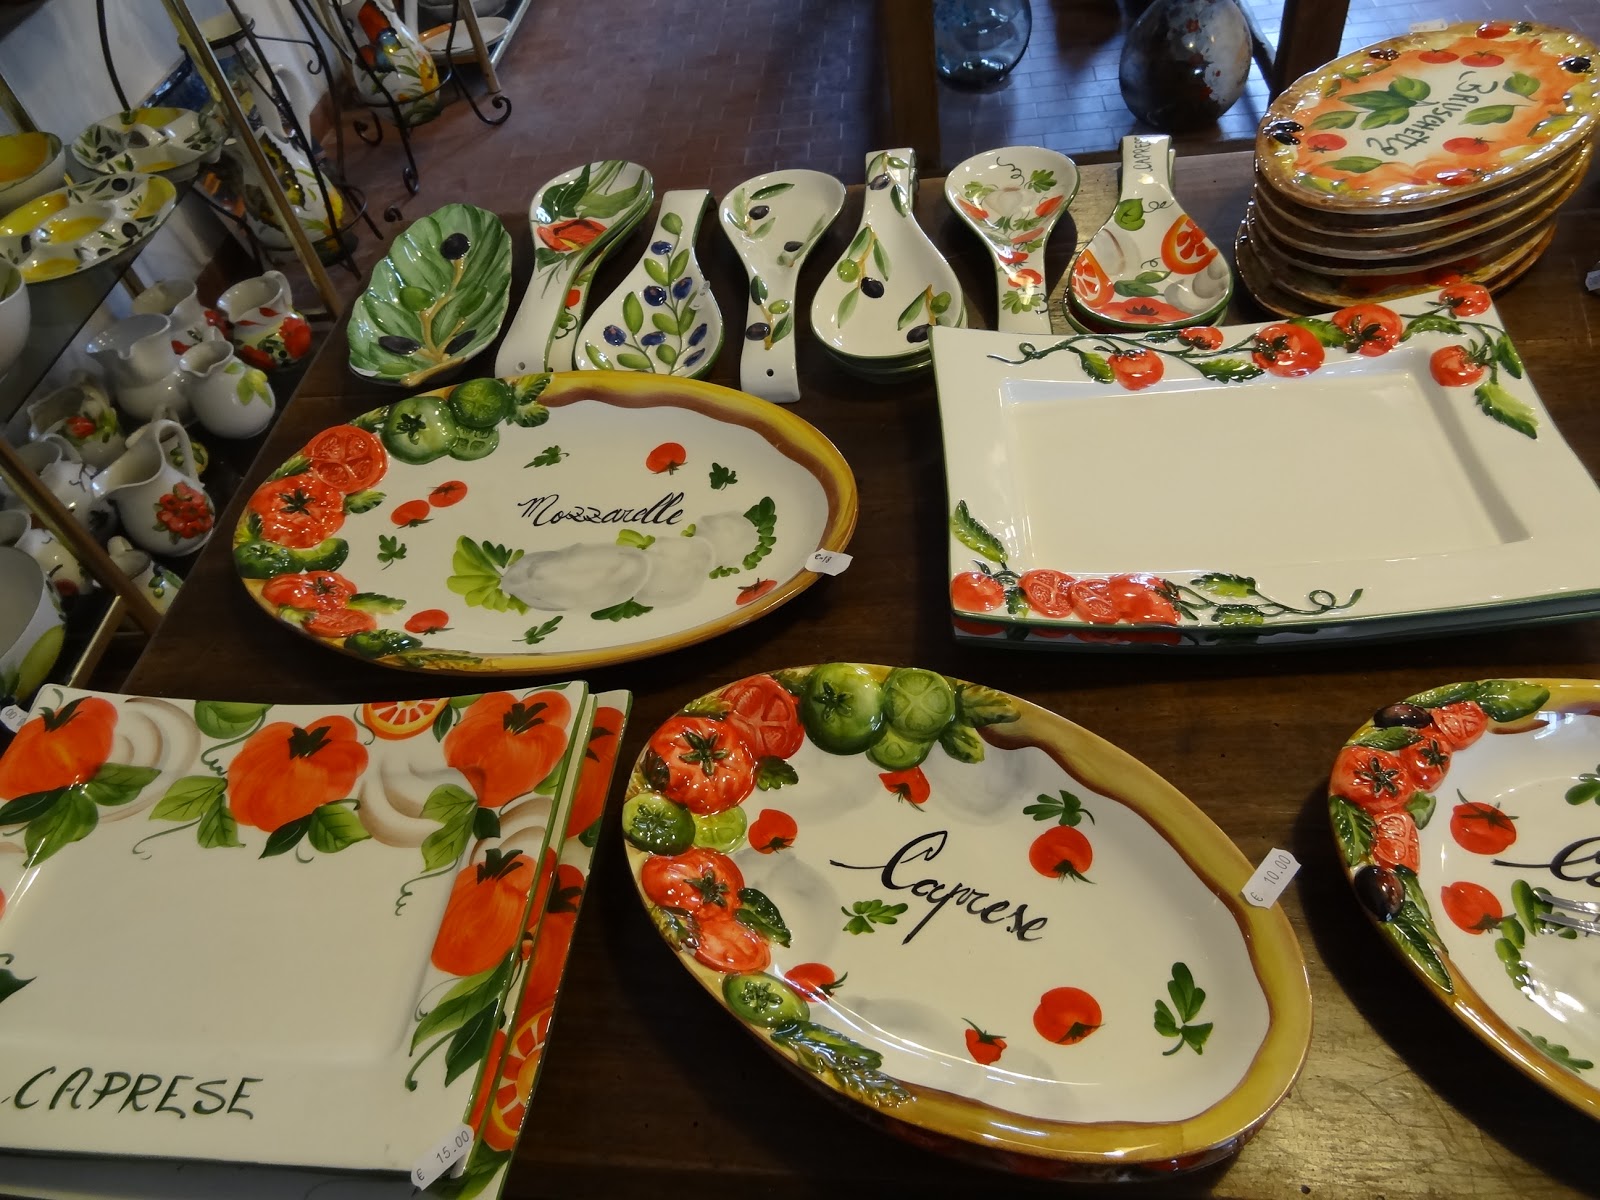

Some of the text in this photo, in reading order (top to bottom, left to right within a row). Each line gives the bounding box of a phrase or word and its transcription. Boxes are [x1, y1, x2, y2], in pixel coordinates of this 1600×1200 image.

[1132, 136, 1153, 172] CAPRE
[517, 491, 685, 527] Mozzarelle
[1263, 854, 1291, 885] 10.00
[829, 830, 1048, 946] Caprese
[13, 1065, 264, 1120] CAPRESE
[436, 1130, 470, 1164] 15.00
